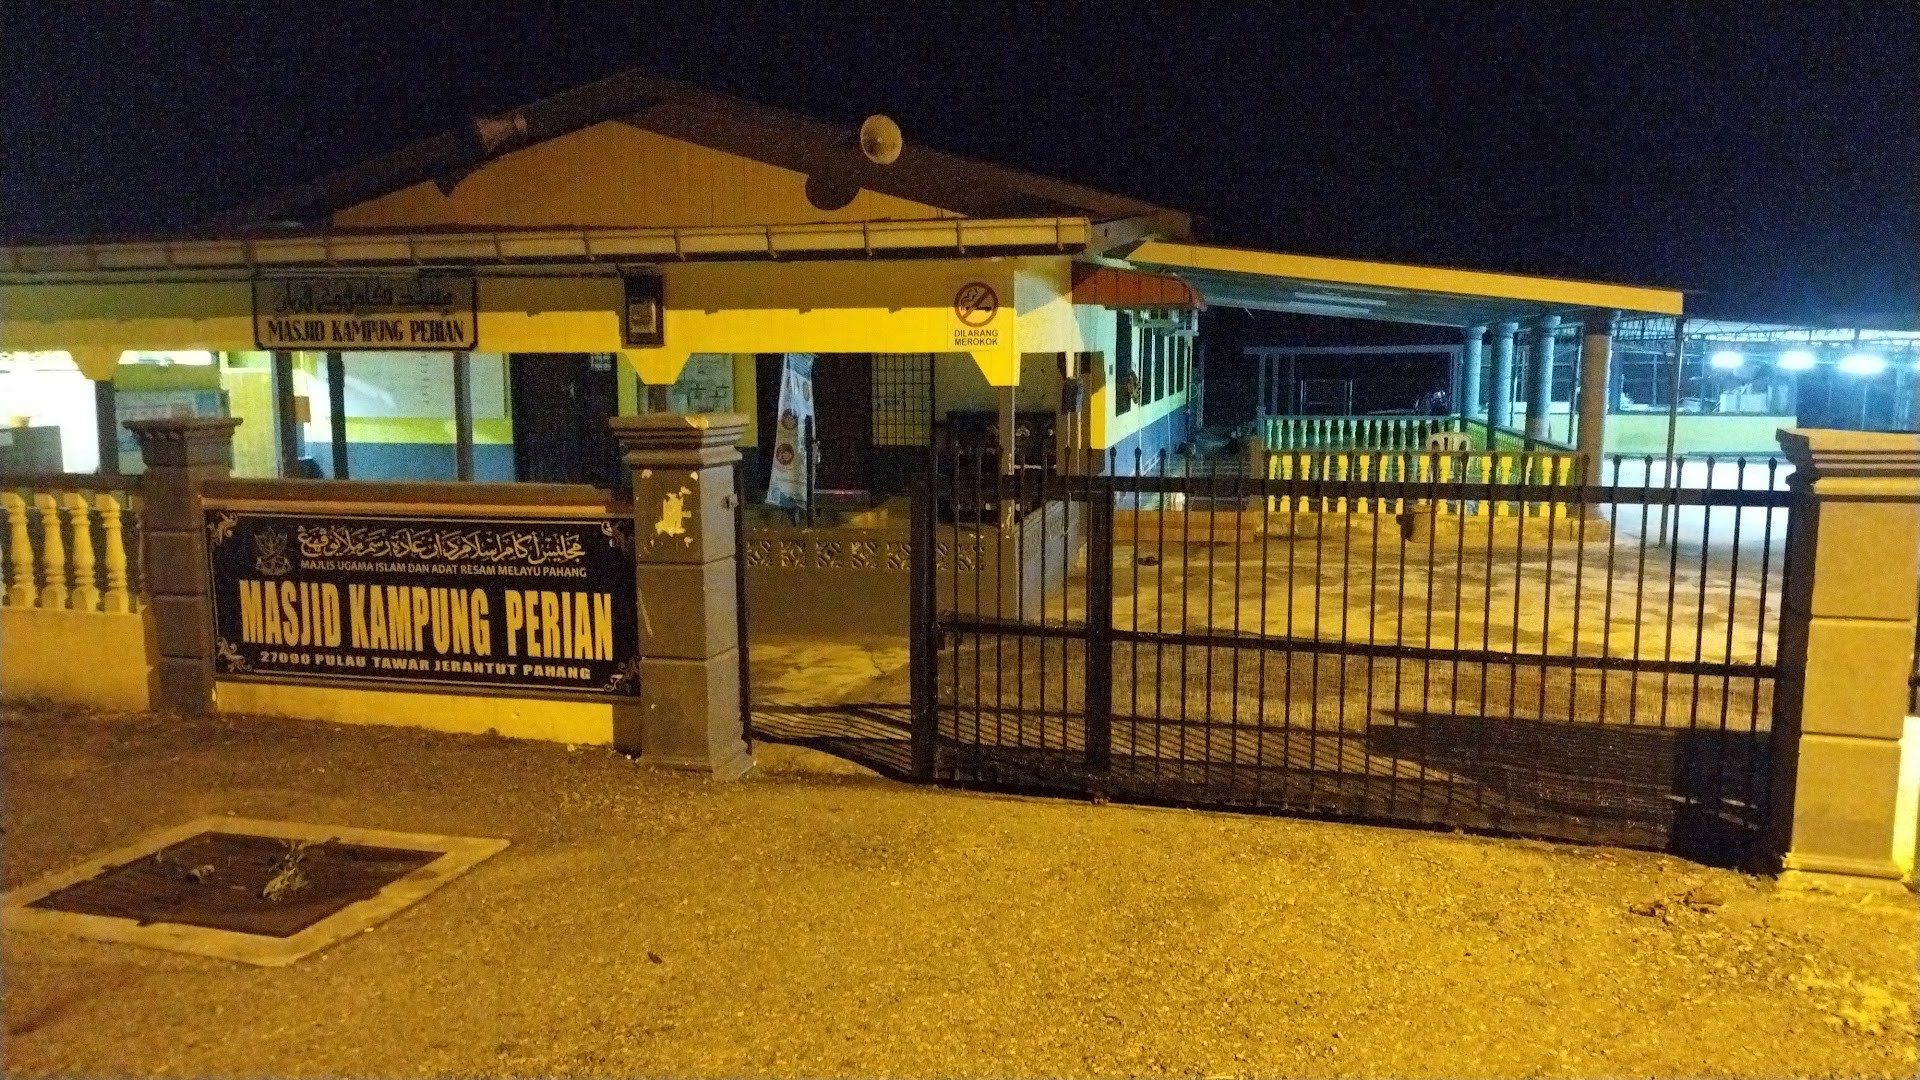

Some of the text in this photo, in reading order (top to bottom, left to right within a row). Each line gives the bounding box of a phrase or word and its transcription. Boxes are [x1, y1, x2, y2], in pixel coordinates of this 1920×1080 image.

[267, 319, 465, 343] MASJID KAMPUNG PERIAN
[954, 329, 998, 338] DILARANG
[954, 338, 998, 346] MEROKOK
[301, 560, 587, 578] MAJLIS UGAMA ISLAM DAN ADAT RESAM MELAYU PAHANG
[239, 579, 613, 661] MASJID KAMPUNG PERIAN
[260, 651, 591, 680] 27090 PULAU TAWAR JERANTUT PAHANG
